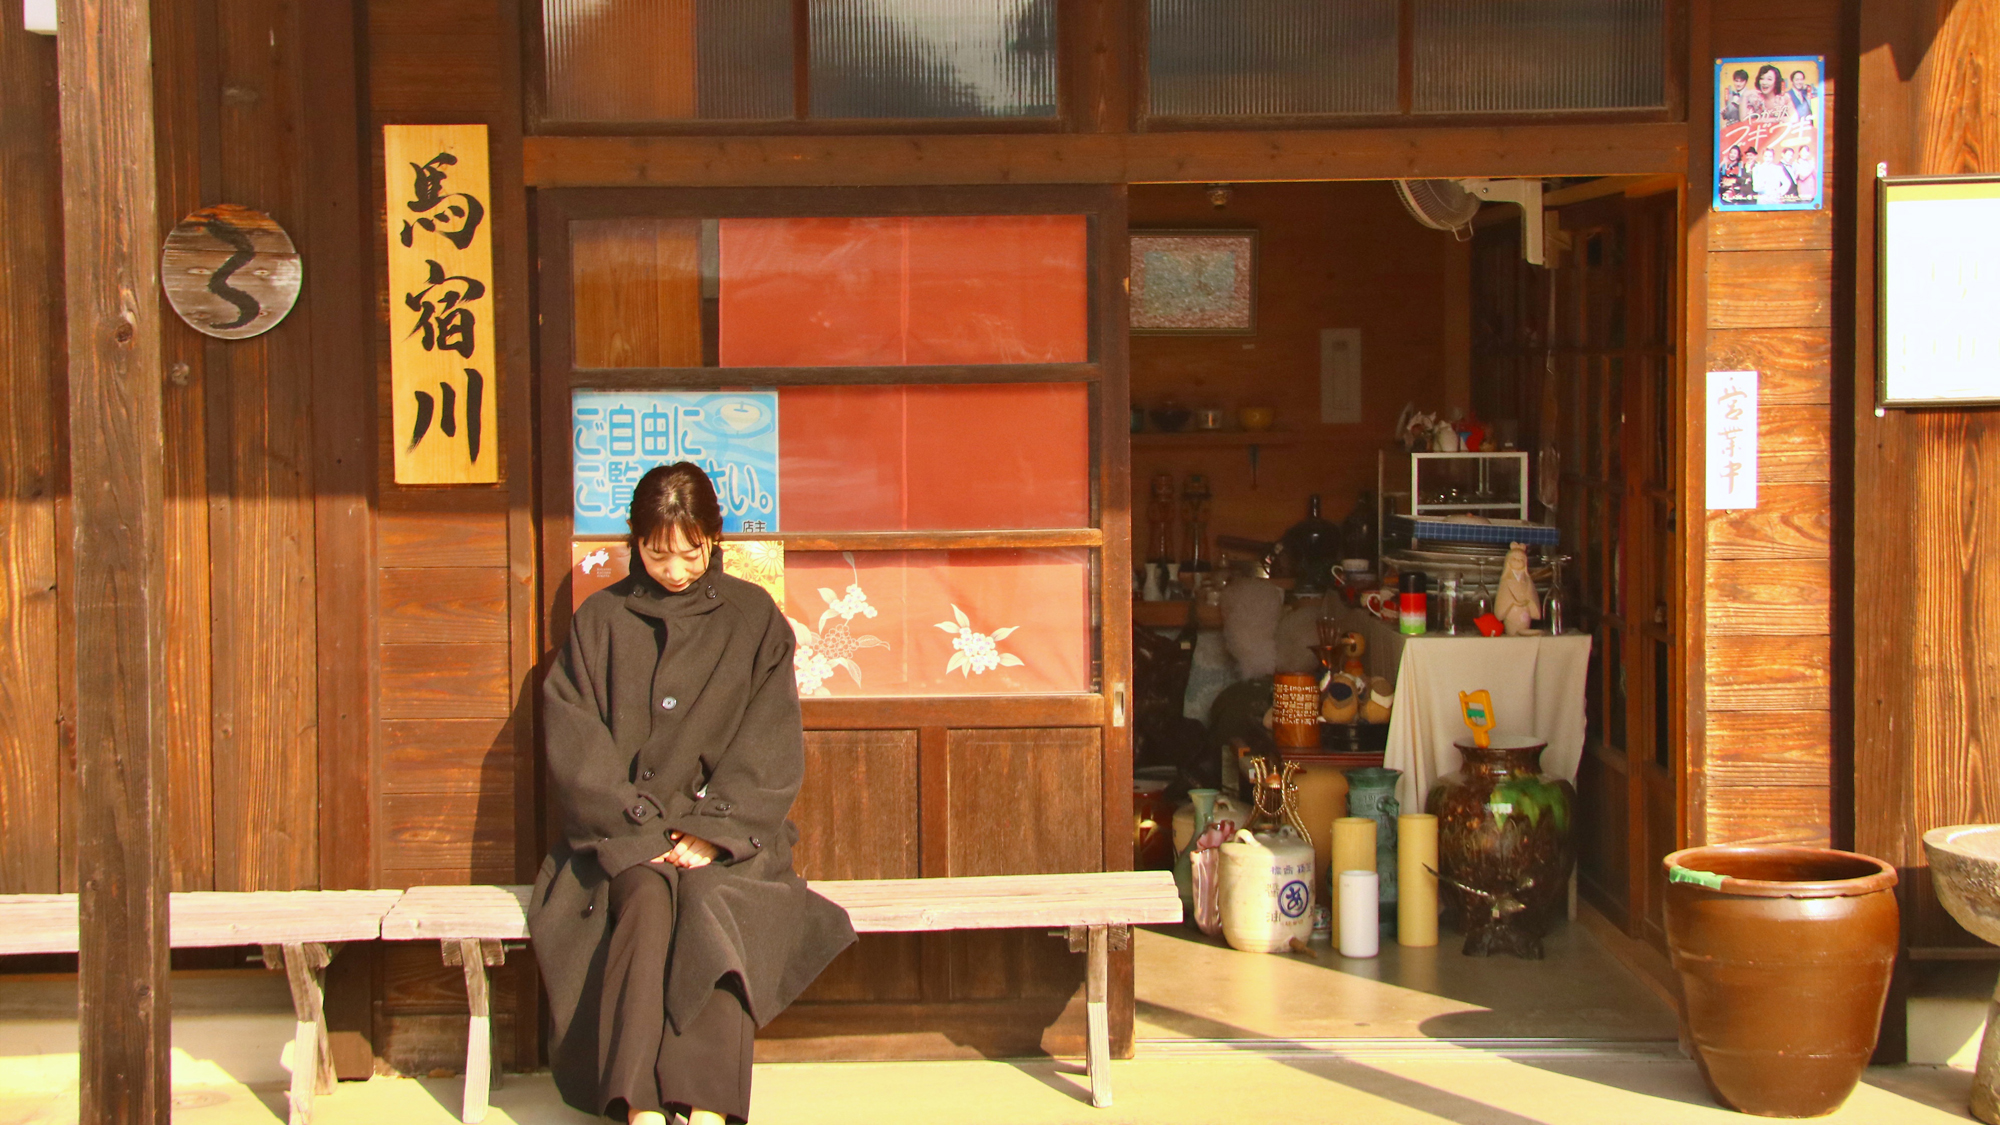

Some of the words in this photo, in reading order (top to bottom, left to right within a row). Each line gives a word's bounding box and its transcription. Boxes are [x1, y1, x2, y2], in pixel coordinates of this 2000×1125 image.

[400, 152, 485, 466] 馬宿川
[574, 402, 706, 459] ご自由に
[1717, 385, 1748, 495] 営業中
[574, 460, 773, 517] ご覧さい。
[742, 520, 767, 533] 店主
